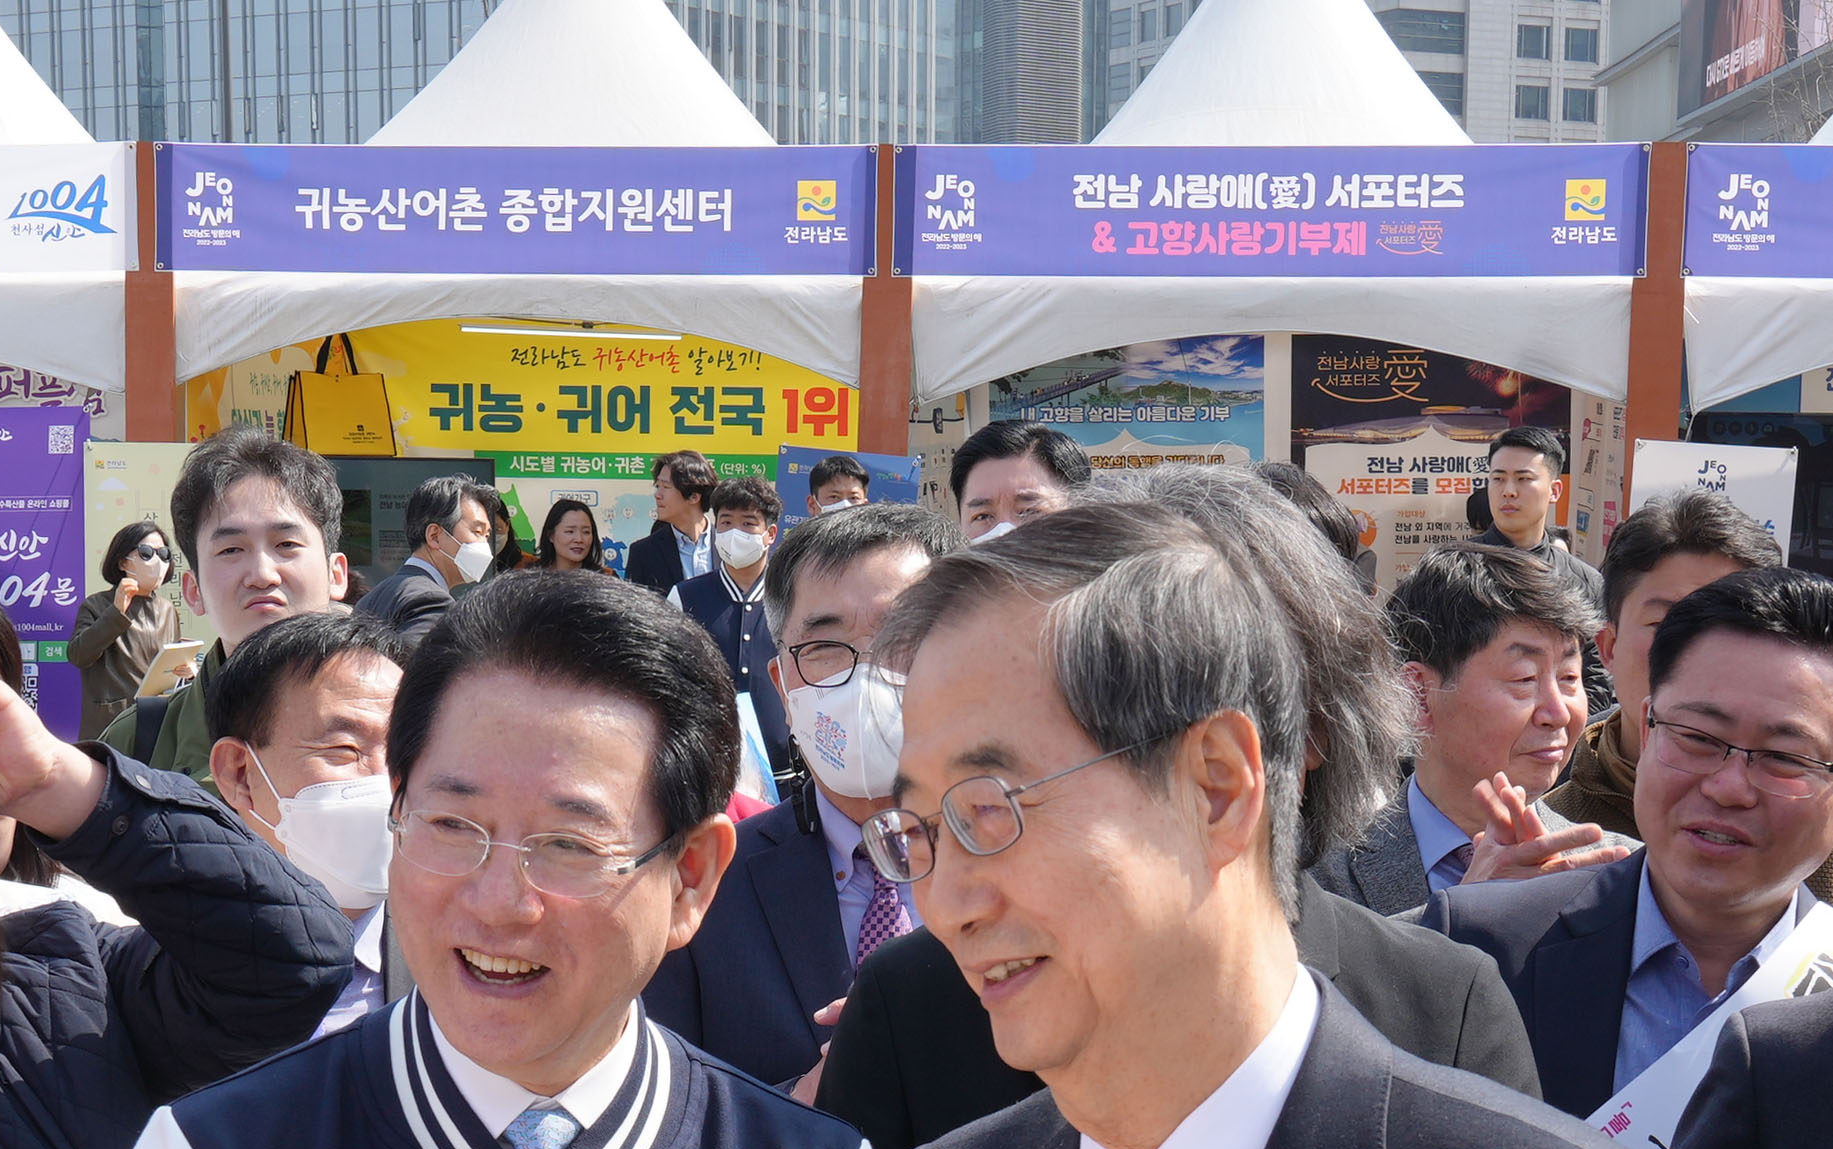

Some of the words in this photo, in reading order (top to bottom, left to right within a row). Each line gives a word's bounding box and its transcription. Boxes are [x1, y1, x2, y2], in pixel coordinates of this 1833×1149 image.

[1072, 173, 1142, 209] 전남
[1149, 172, 1316, 210] 사랑애(愛)
[1325, 173, 1465, 209] 서포터즈
[295, 187, 488, 232] 귀농산어촌
[499, 188, 733, 232] 종합지원센터
[784, 226, 849, 244] 전라남도
[1091, 220, 1117, 254] &
[1126, 220, 1367, 256] 고향사랑기부제
[1551, 226, 1618, 245] 전라남도
[510, 346, 587, 370] 전라남도
[592, 347, 681, 374] 귀농산어촌
[687, 347, 764, 376] 알아보기!
[1317, 356, 1380, 371] 전남사랑
[1325, 373, 1381, 387] 서포터즈
[669, 386, 765, 436] 전국
[782, 387, 849, 437] 1위
[1040, 407, 1083, 423] 고향을
[1087, 406, 1132, 423] 살리는
[1136, 406, 1196, 423] 아름다운
[1200, 405, 1230, 422] 기부
[510, 456, 555, 473] 시도별
[561, 456, 645, 474] 귀농어·귀촌
[1090, 455, 1126, 468] 당신의
[1367, 456, 1405, 473] 전남
[1337, 477, 1429, 496] 서포터즈를
[1394, 522, 1412, 532] 전남
[46, 646, 63, 657] 검색
